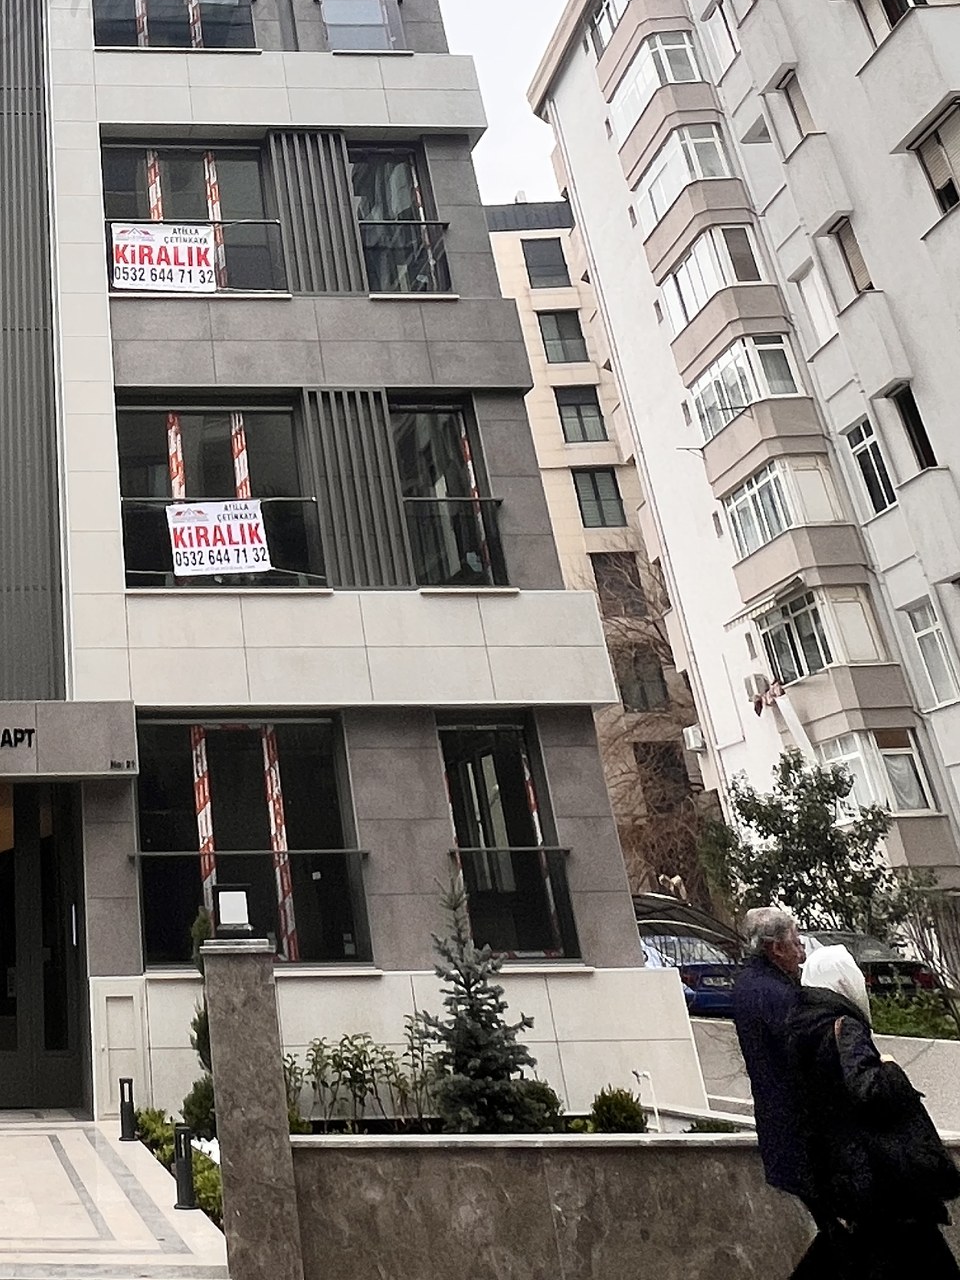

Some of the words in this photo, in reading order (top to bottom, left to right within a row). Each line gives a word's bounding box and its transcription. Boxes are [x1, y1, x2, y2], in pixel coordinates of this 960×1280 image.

[114, 266, 146, 281] 0532
[150, 268, 173, 282] 644
[179, 269, 193, 283] 71
[199, 270, 214, 284] 32
[175, 551, 205, 567] 0532
[208, 548, 230, 565] 644
[234, 548, 248, 563] 71
[252, 546, 267, 563] 32
[0, 727, 35, 749] APT
